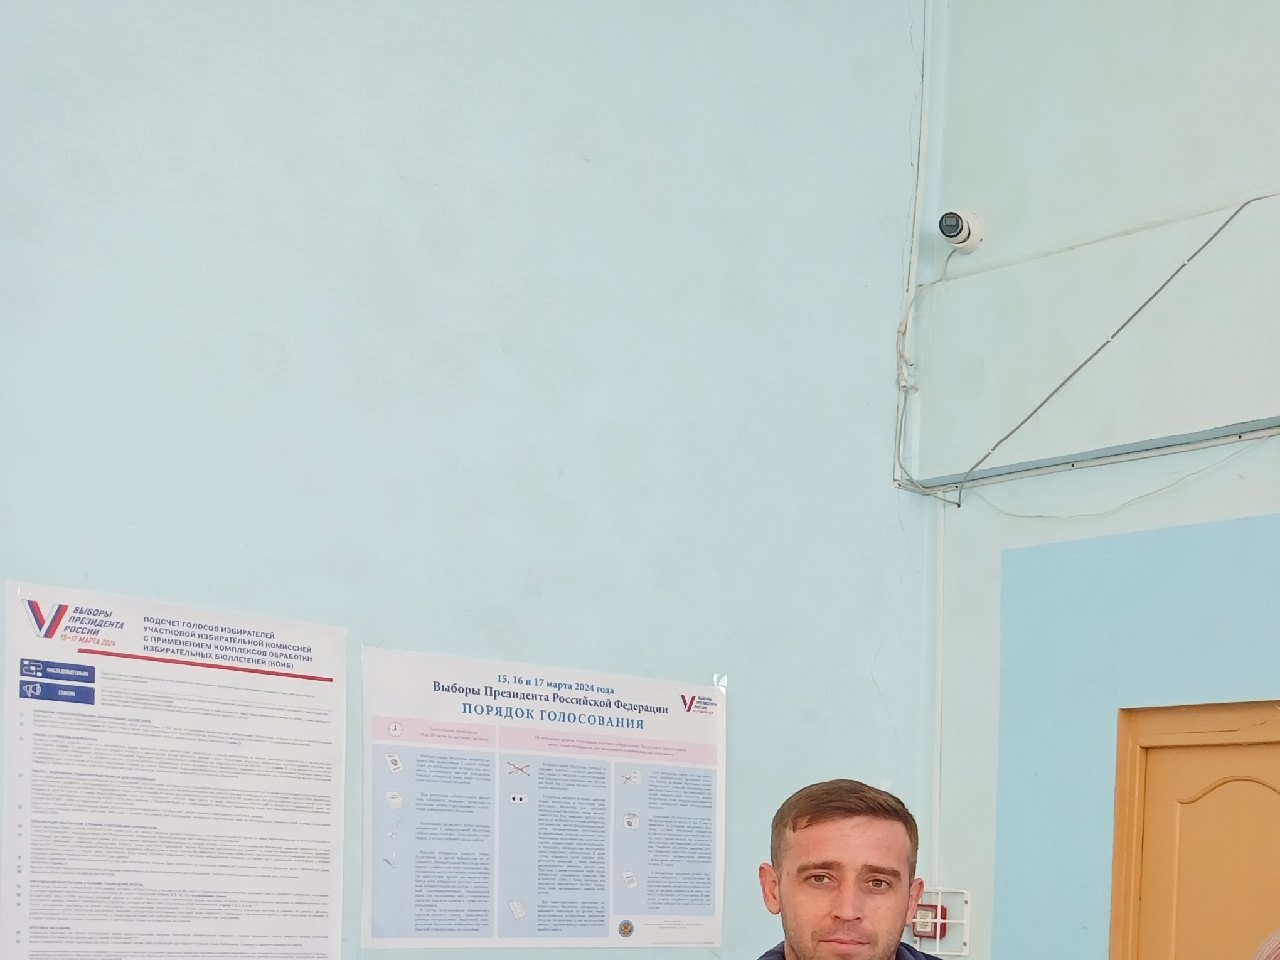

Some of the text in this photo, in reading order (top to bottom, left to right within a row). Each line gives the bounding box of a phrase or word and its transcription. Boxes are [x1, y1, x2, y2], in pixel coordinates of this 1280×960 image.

[68, 615, 124, 630] ПРЕЗИДЕНТА
[73, 606, 112, 618] ВЫБОРЫ
[63, 625, 101, 636] РОССИИ
[143, 616, 275, 640] ПОДСЧЕТ ГОЛОСОВ ИЗБИРАТЕЛЕЙ
[143, 626, 312, 654] УЧАСТКОВОЙ ИЗБИРАТЕЛЬНОЙ КОМИССИЕЙ
[150, 636, 212, 650] ПРИМЕНЕНИЕМ
[214, 644, 268, 657] КОМПЛЕКСОВ
[268, 651, 313, 662] ОБРАБОТКИ
[143, 645, 213, 660] ИЗБИРАТЕЛЬНЫХ
[214, 653, 266, 666] БЮЛЛЕТЕНЕЙ
[497, 674, 615, 695] 15, 16 и 17 марта 2024 года
[433, 680, 668, 714] Выборы Президента Российской Федерации
[461, 702, 645, 730] ПОРЯДОК ГОЛОСОВАНИЯ
